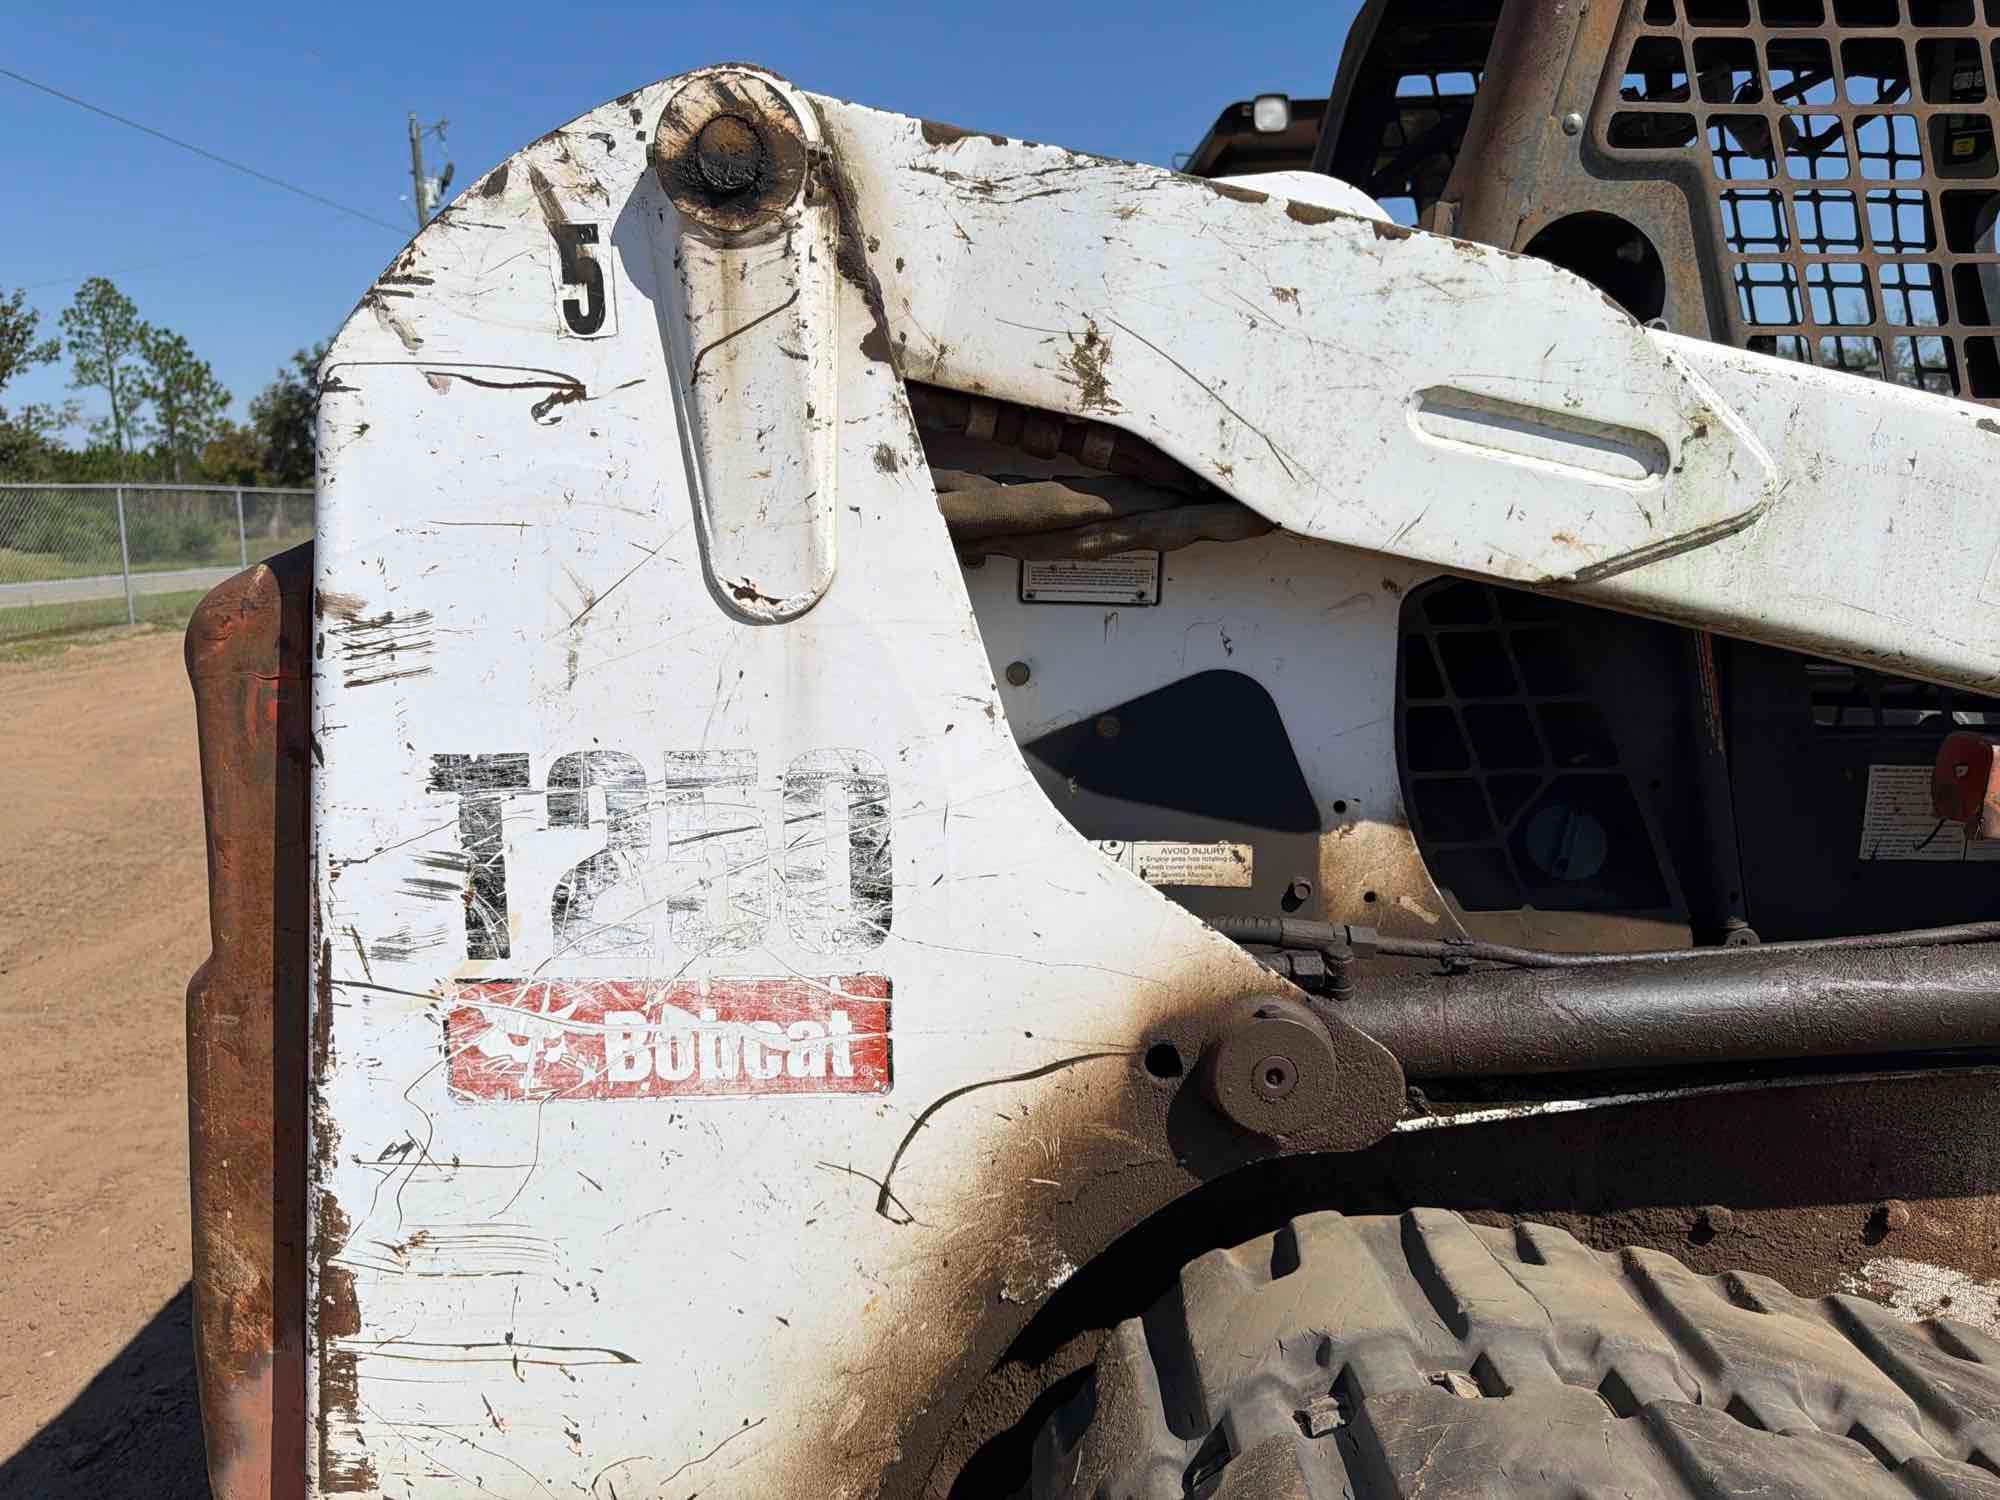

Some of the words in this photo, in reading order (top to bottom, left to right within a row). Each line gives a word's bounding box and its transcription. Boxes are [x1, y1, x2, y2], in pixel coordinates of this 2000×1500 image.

[560, 223, 606, 335] 5
[429, 749, 894, 960] T250
[1160, 847, 1190, 855] AVOID
[1192, 847, 1226, 855] INJURY
[604, 1008, 852, 1081] Bobcat
